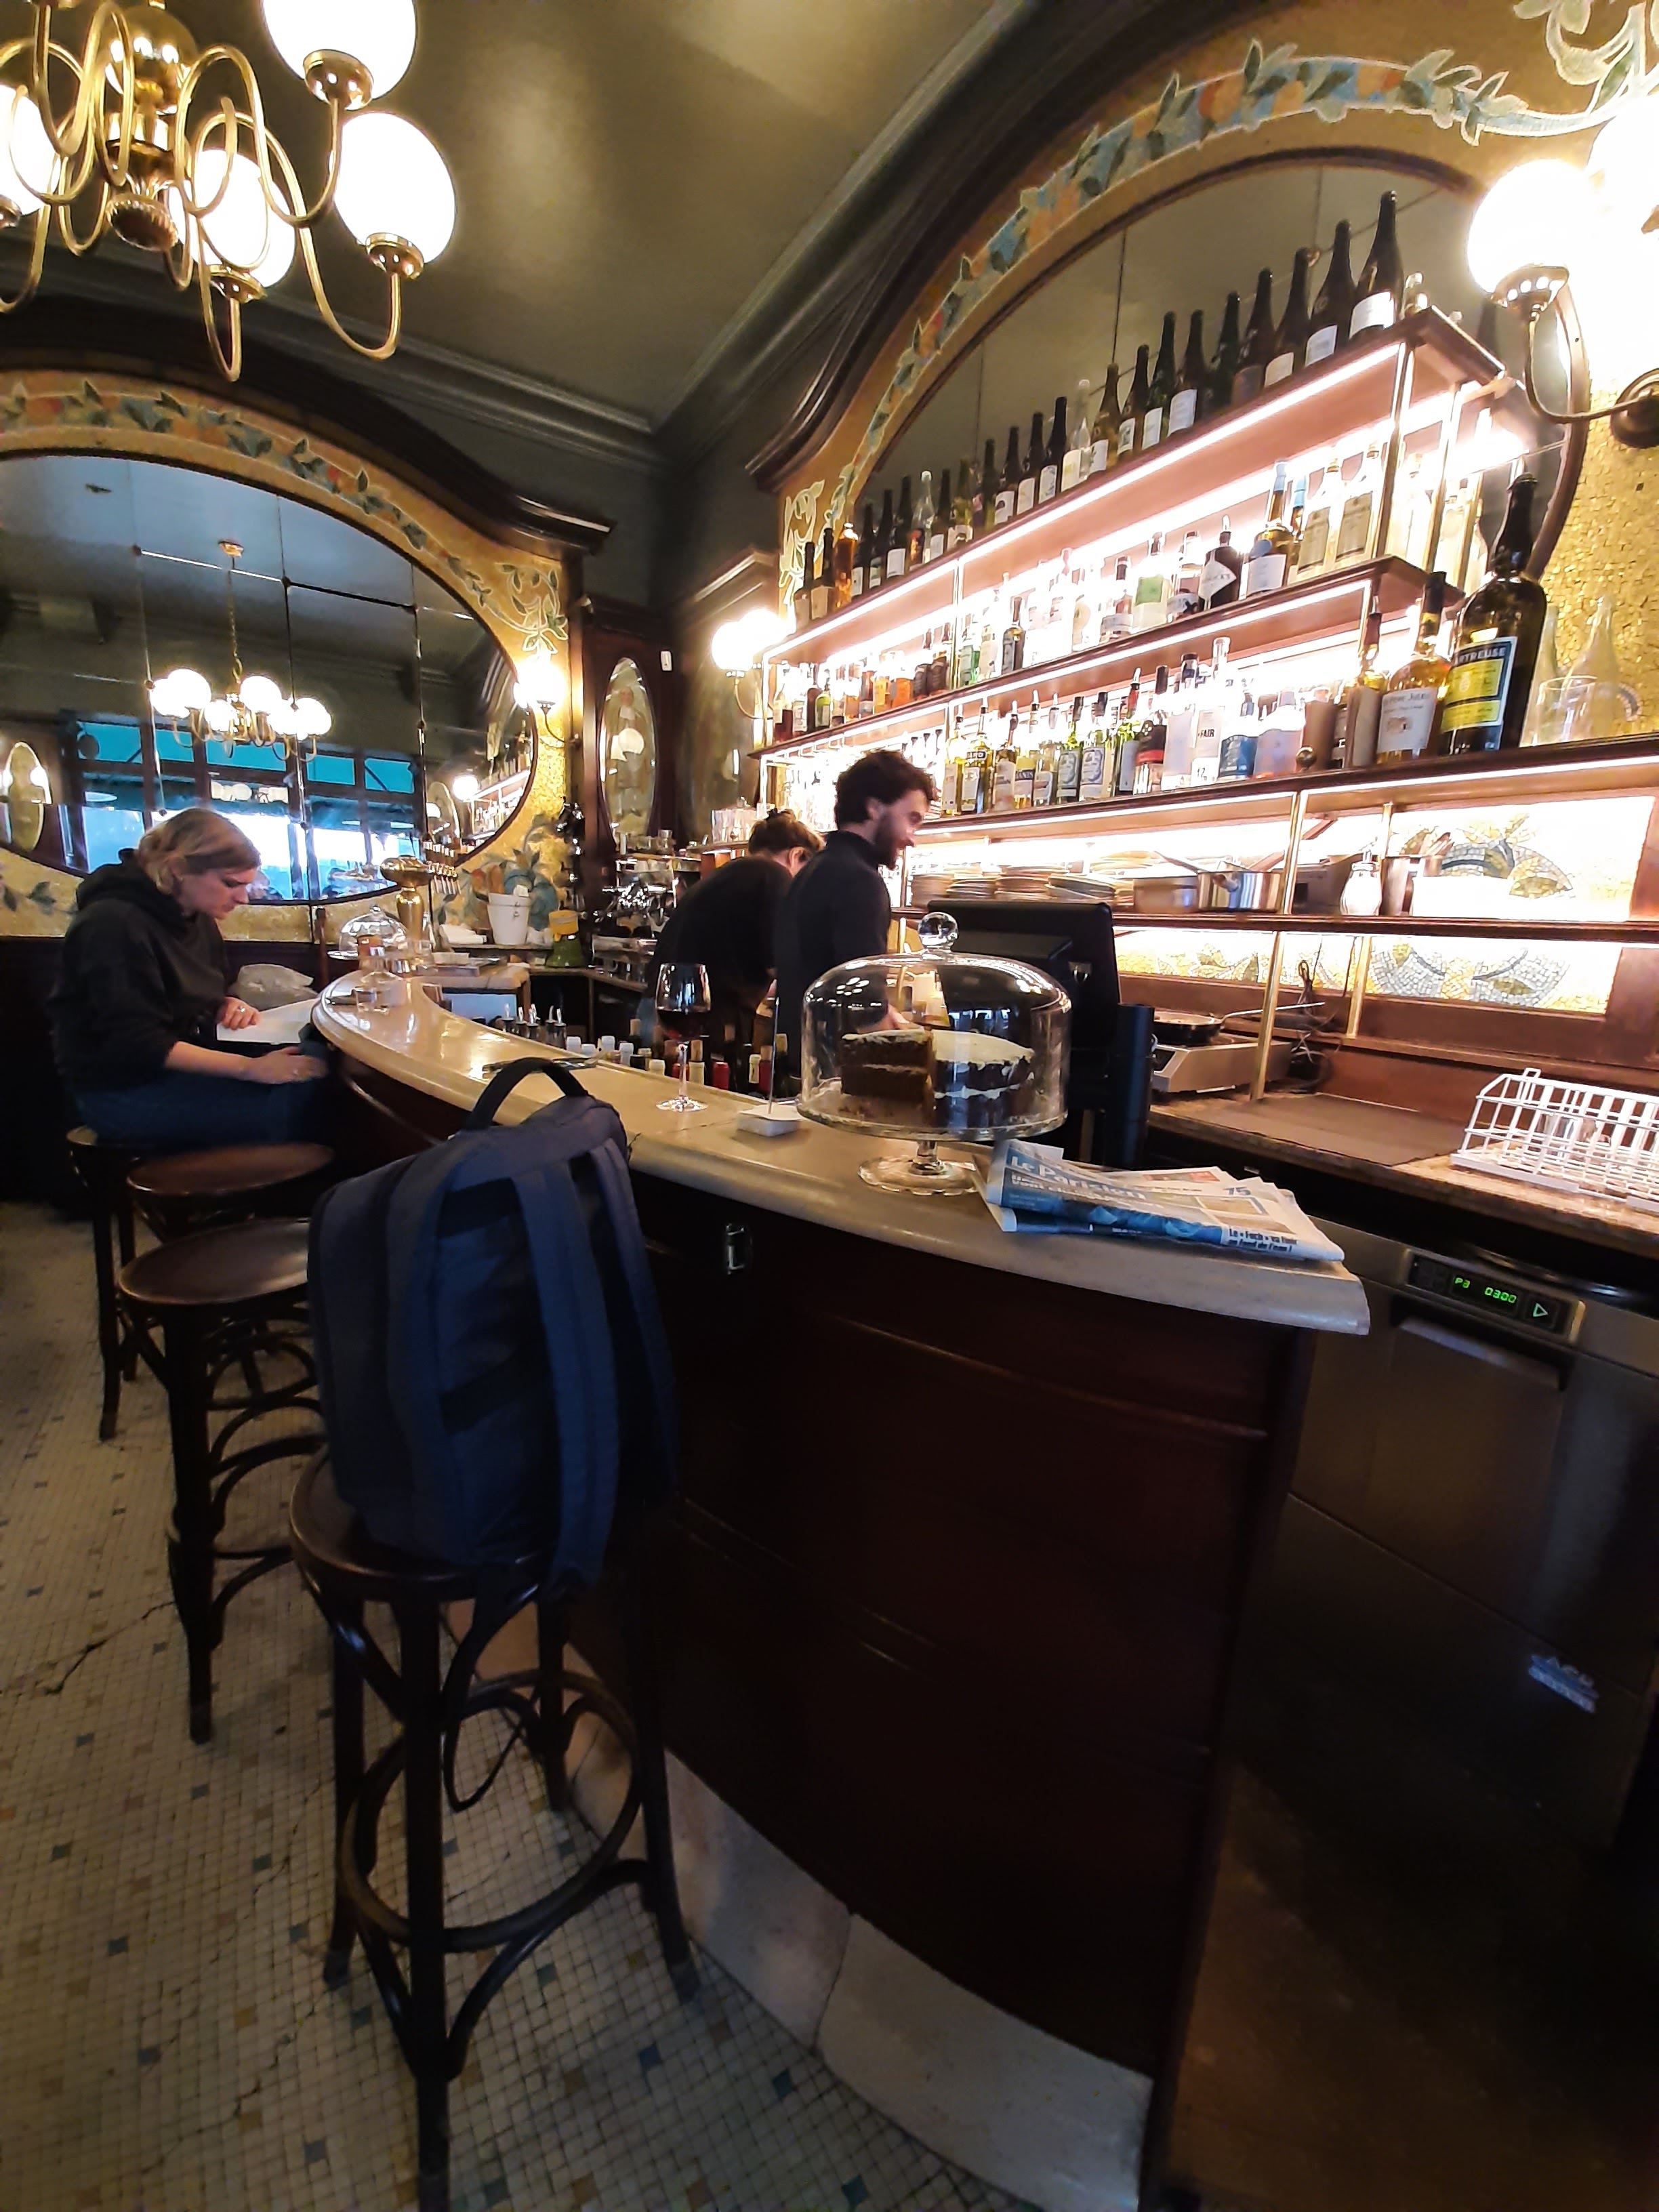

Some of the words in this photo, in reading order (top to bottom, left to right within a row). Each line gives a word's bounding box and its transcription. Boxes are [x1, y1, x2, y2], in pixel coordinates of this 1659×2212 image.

[1457, 647, 1506, 664] RTREUSE
[1200, 729, 1215, 738] FAIR
[1011, 1156, 1035, 1172] Le
[1039, 1164, 1146, 1200] Parisien
